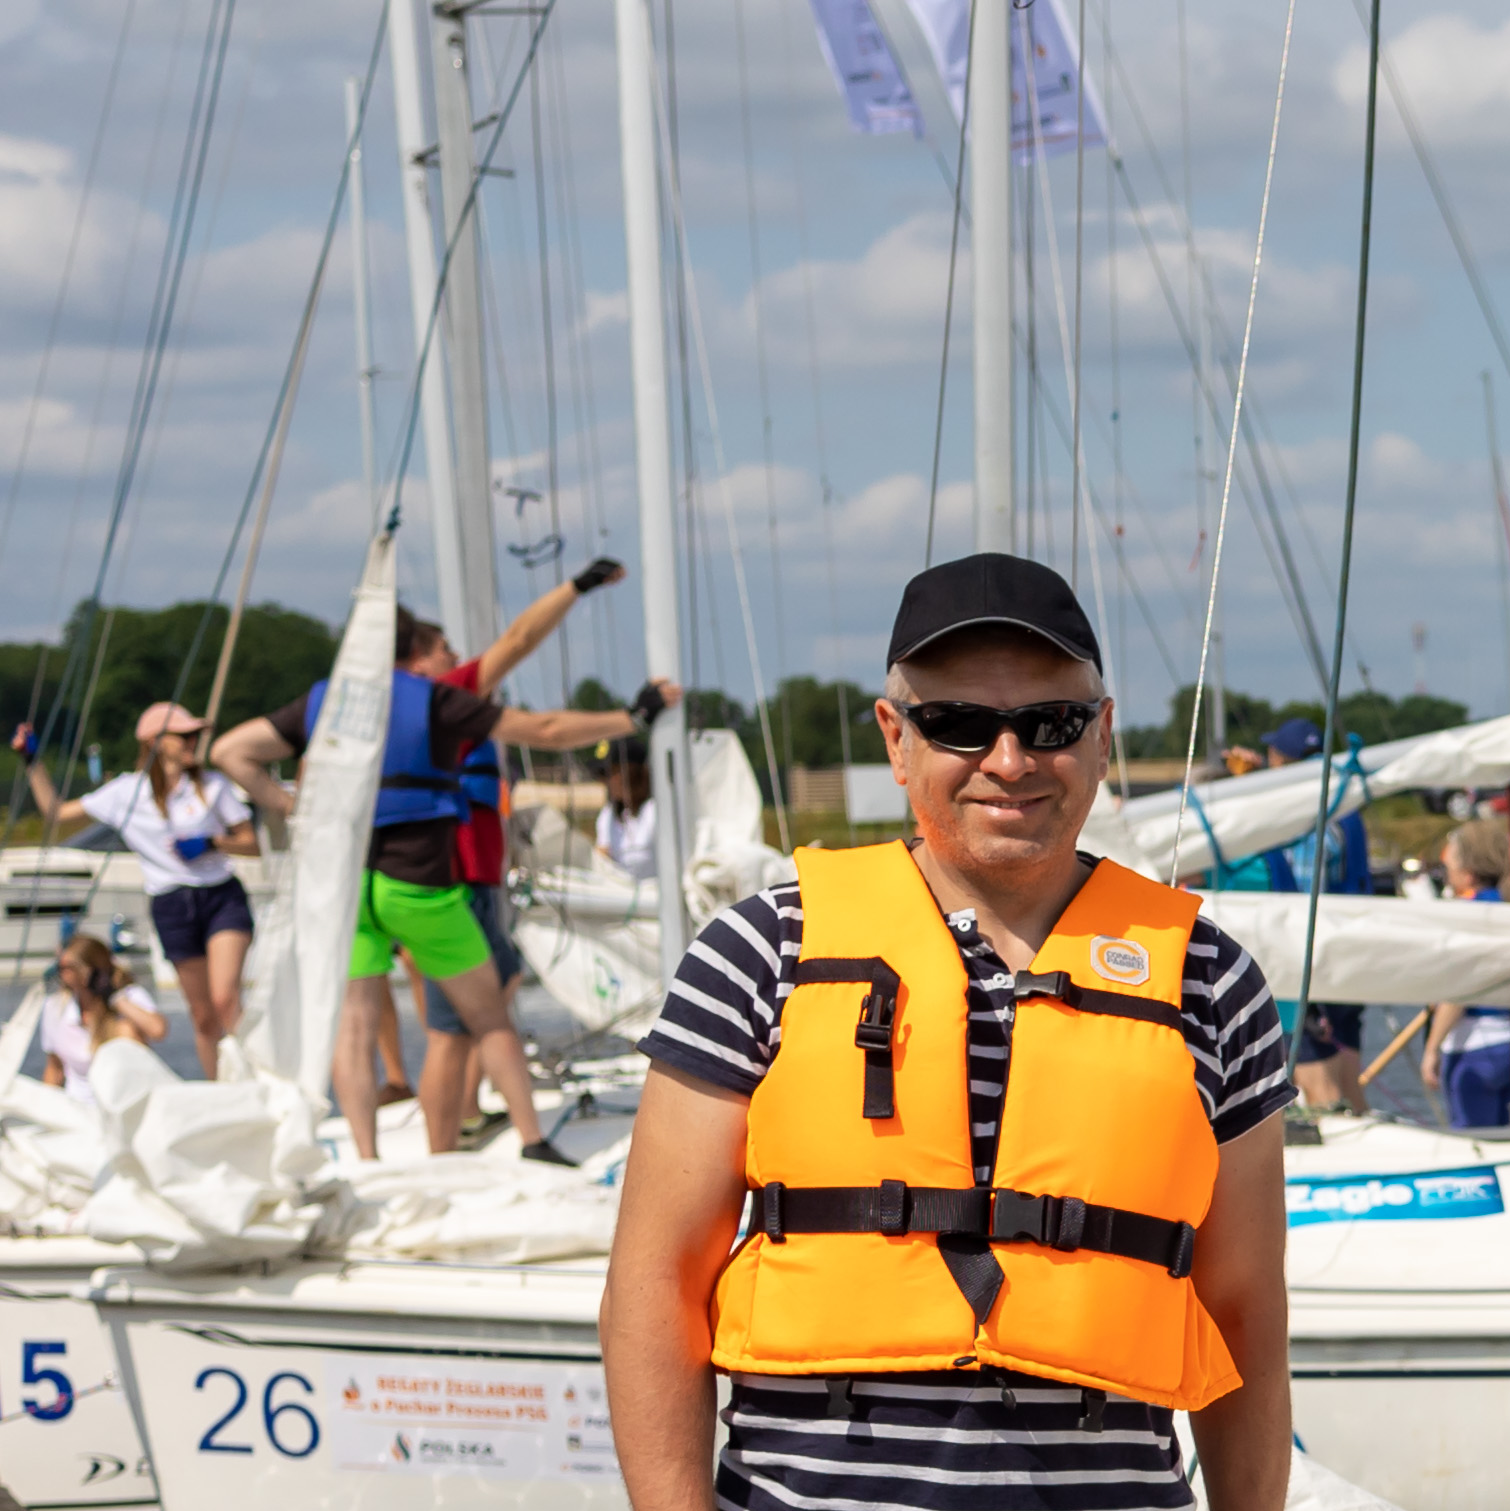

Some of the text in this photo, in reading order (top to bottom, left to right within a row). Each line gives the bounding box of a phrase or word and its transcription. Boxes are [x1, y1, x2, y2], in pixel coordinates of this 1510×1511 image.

[1106, 950, 1144, 964] CONRAD
[21, 1340, 74, 1422] 5
[194, 1366, 321, 1459] 26
[420, 1440, 494, 1457] POLSKA
